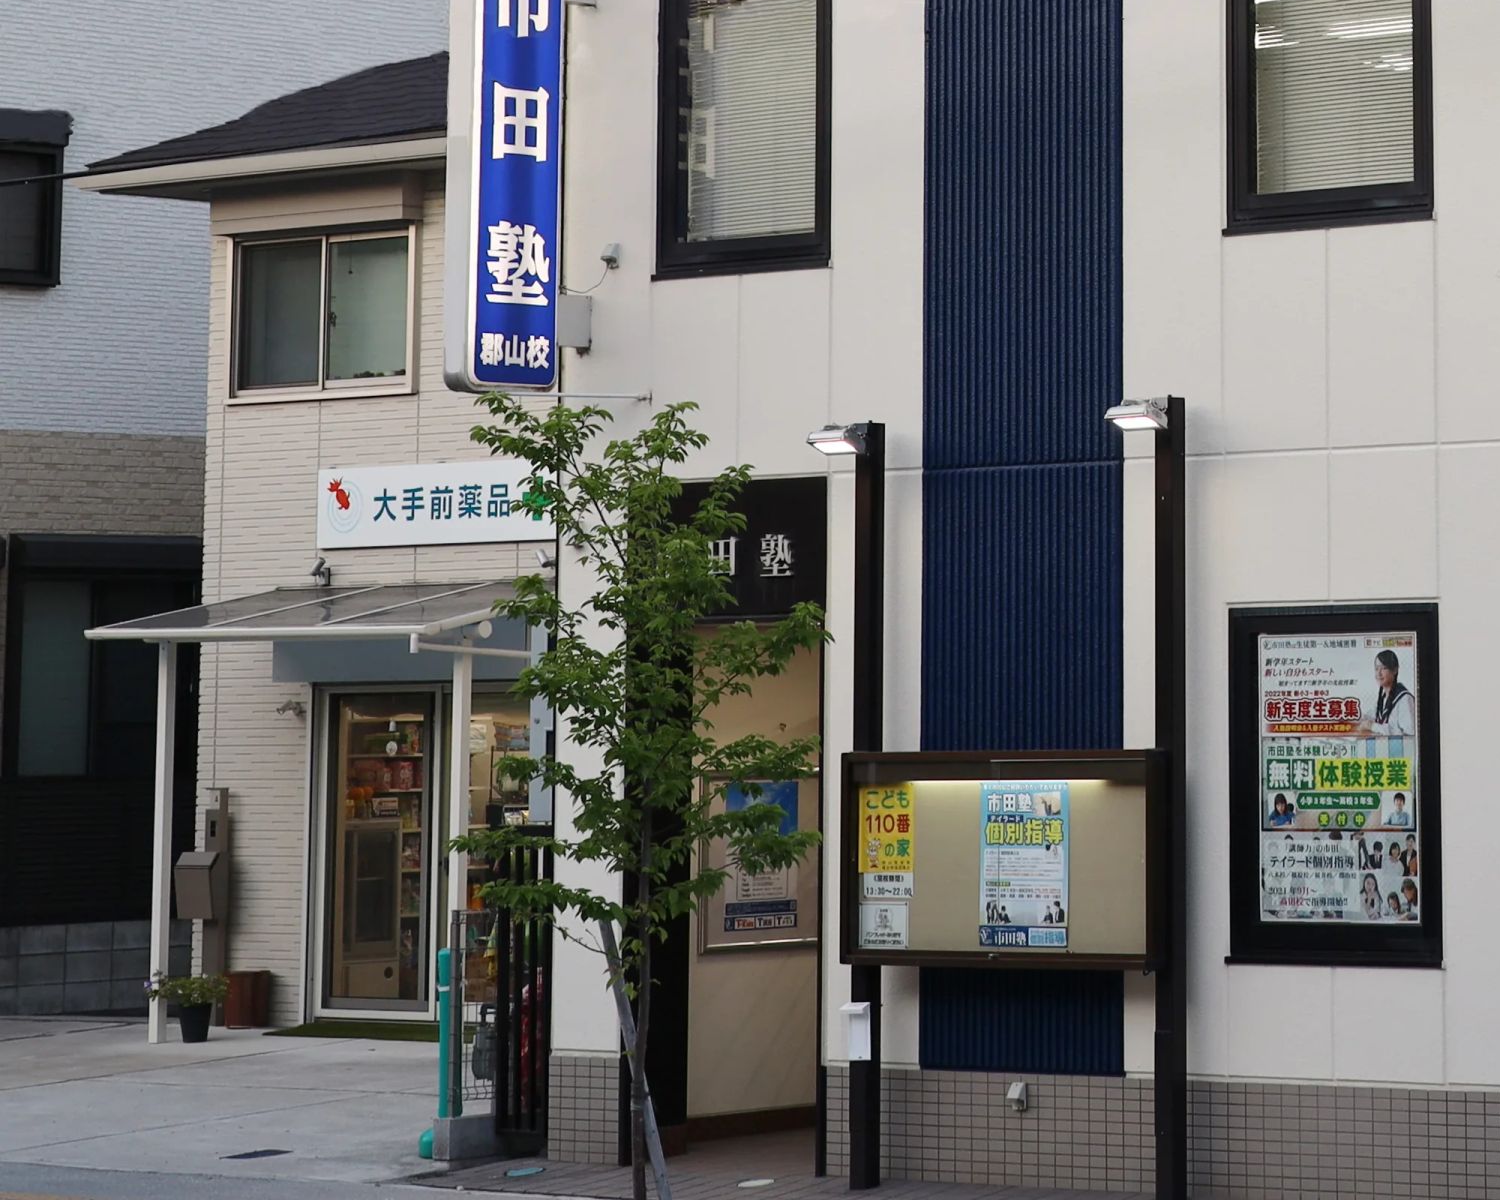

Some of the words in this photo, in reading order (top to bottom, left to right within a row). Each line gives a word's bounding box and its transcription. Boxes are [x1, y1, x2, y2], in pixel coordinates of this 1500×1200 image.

[480, 332, 550, 369] 郡山校
[373, 483, 511, 522] 大手前薬品
[707, 533, 793, 577] 田塾
[1265, 657, 1314, 667] 新学年スタート
[1264, 668, 1334, 678] 新しい自分もスタート
[1266, 699, 1360, 719] 新年度生募集
[1268, 760, 1408, 788] 無料体験授業
[866, 790, 910, 809] こども
[987, 793, 1033, 813] 市田塾
[865, 814, 910, 833] 110番
[1319, 813, 1365, 826] 受付中
[985, 819, 1063, 845] 個別指導
[884, 839, 910, 857] の家
[1270, 856, 1354, 869] テイラード個別指導
